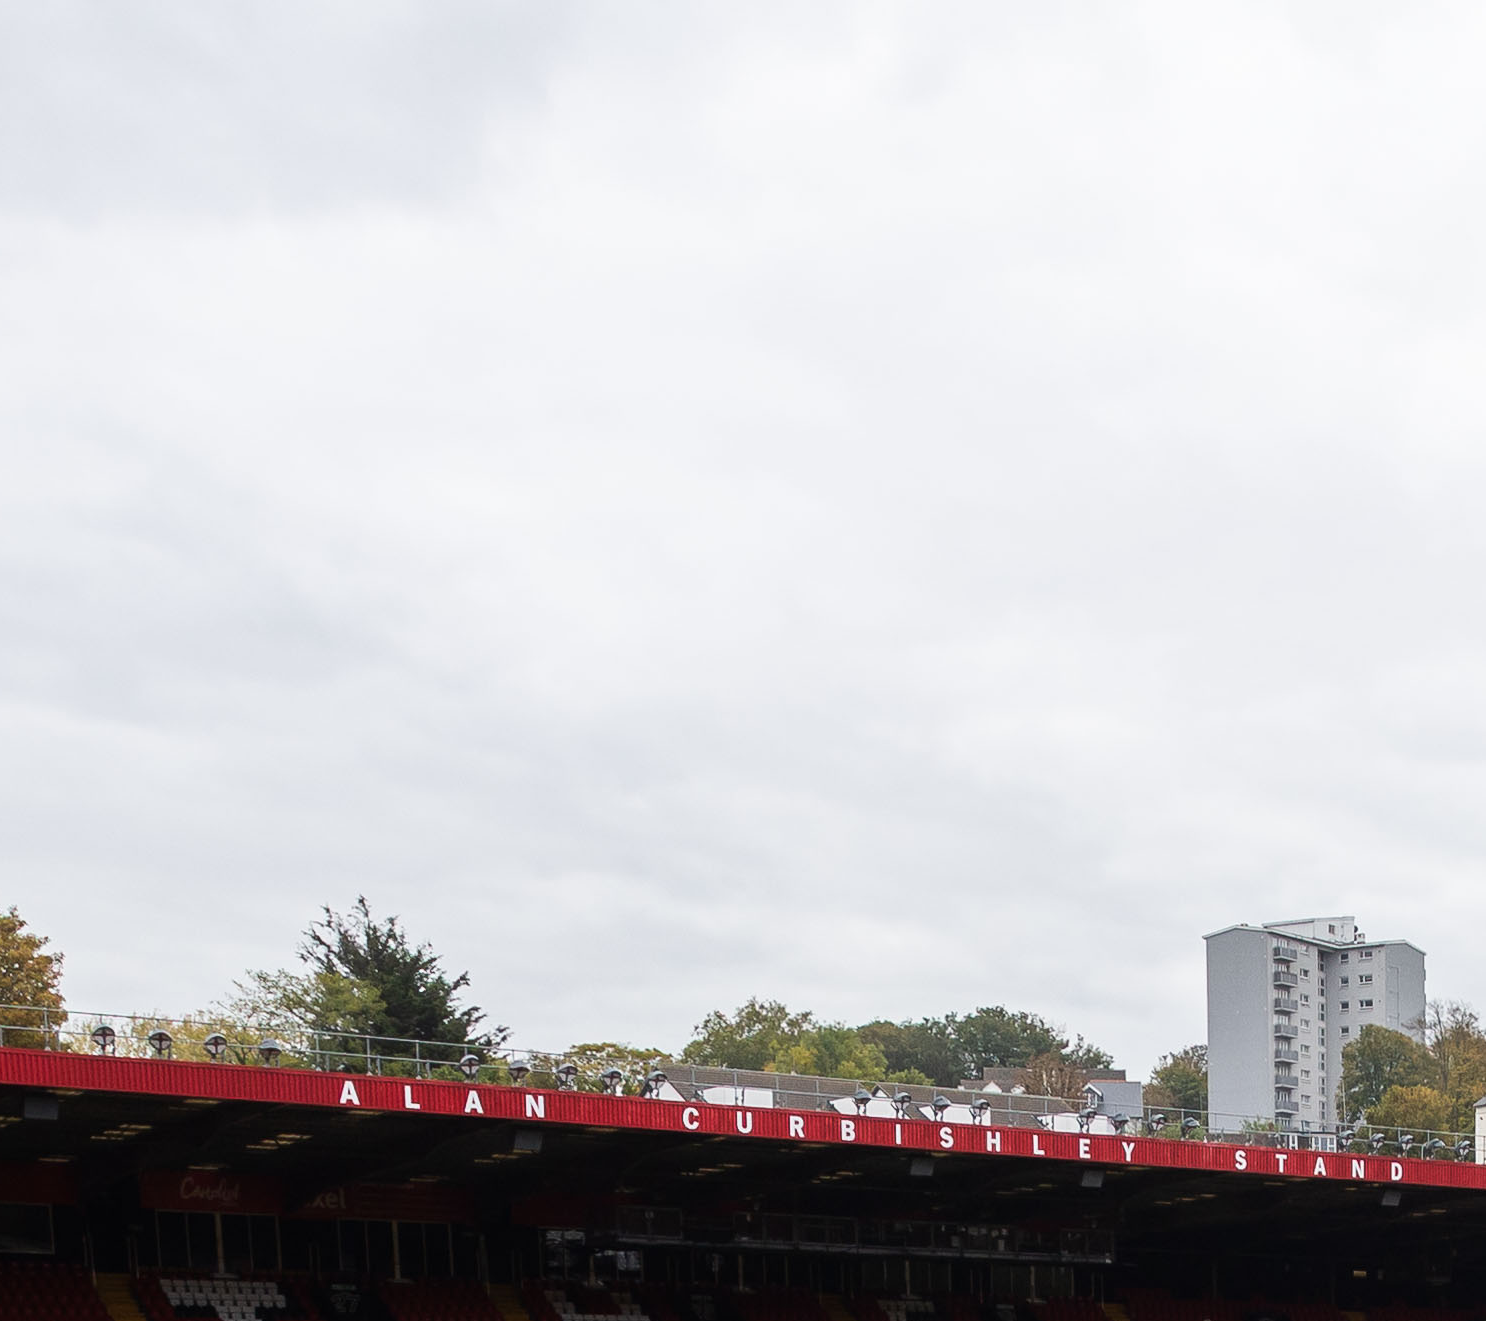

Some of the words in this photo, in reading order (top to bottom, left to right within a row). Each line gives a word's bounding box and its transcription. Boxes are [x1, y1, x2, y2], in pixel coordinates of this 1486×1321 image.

[340, 1081, 545, 1119] ALAN
[683, 1105, 1136, 1163] CURBISHLEY
[1236, 1150, 1404, 1181] STAND
